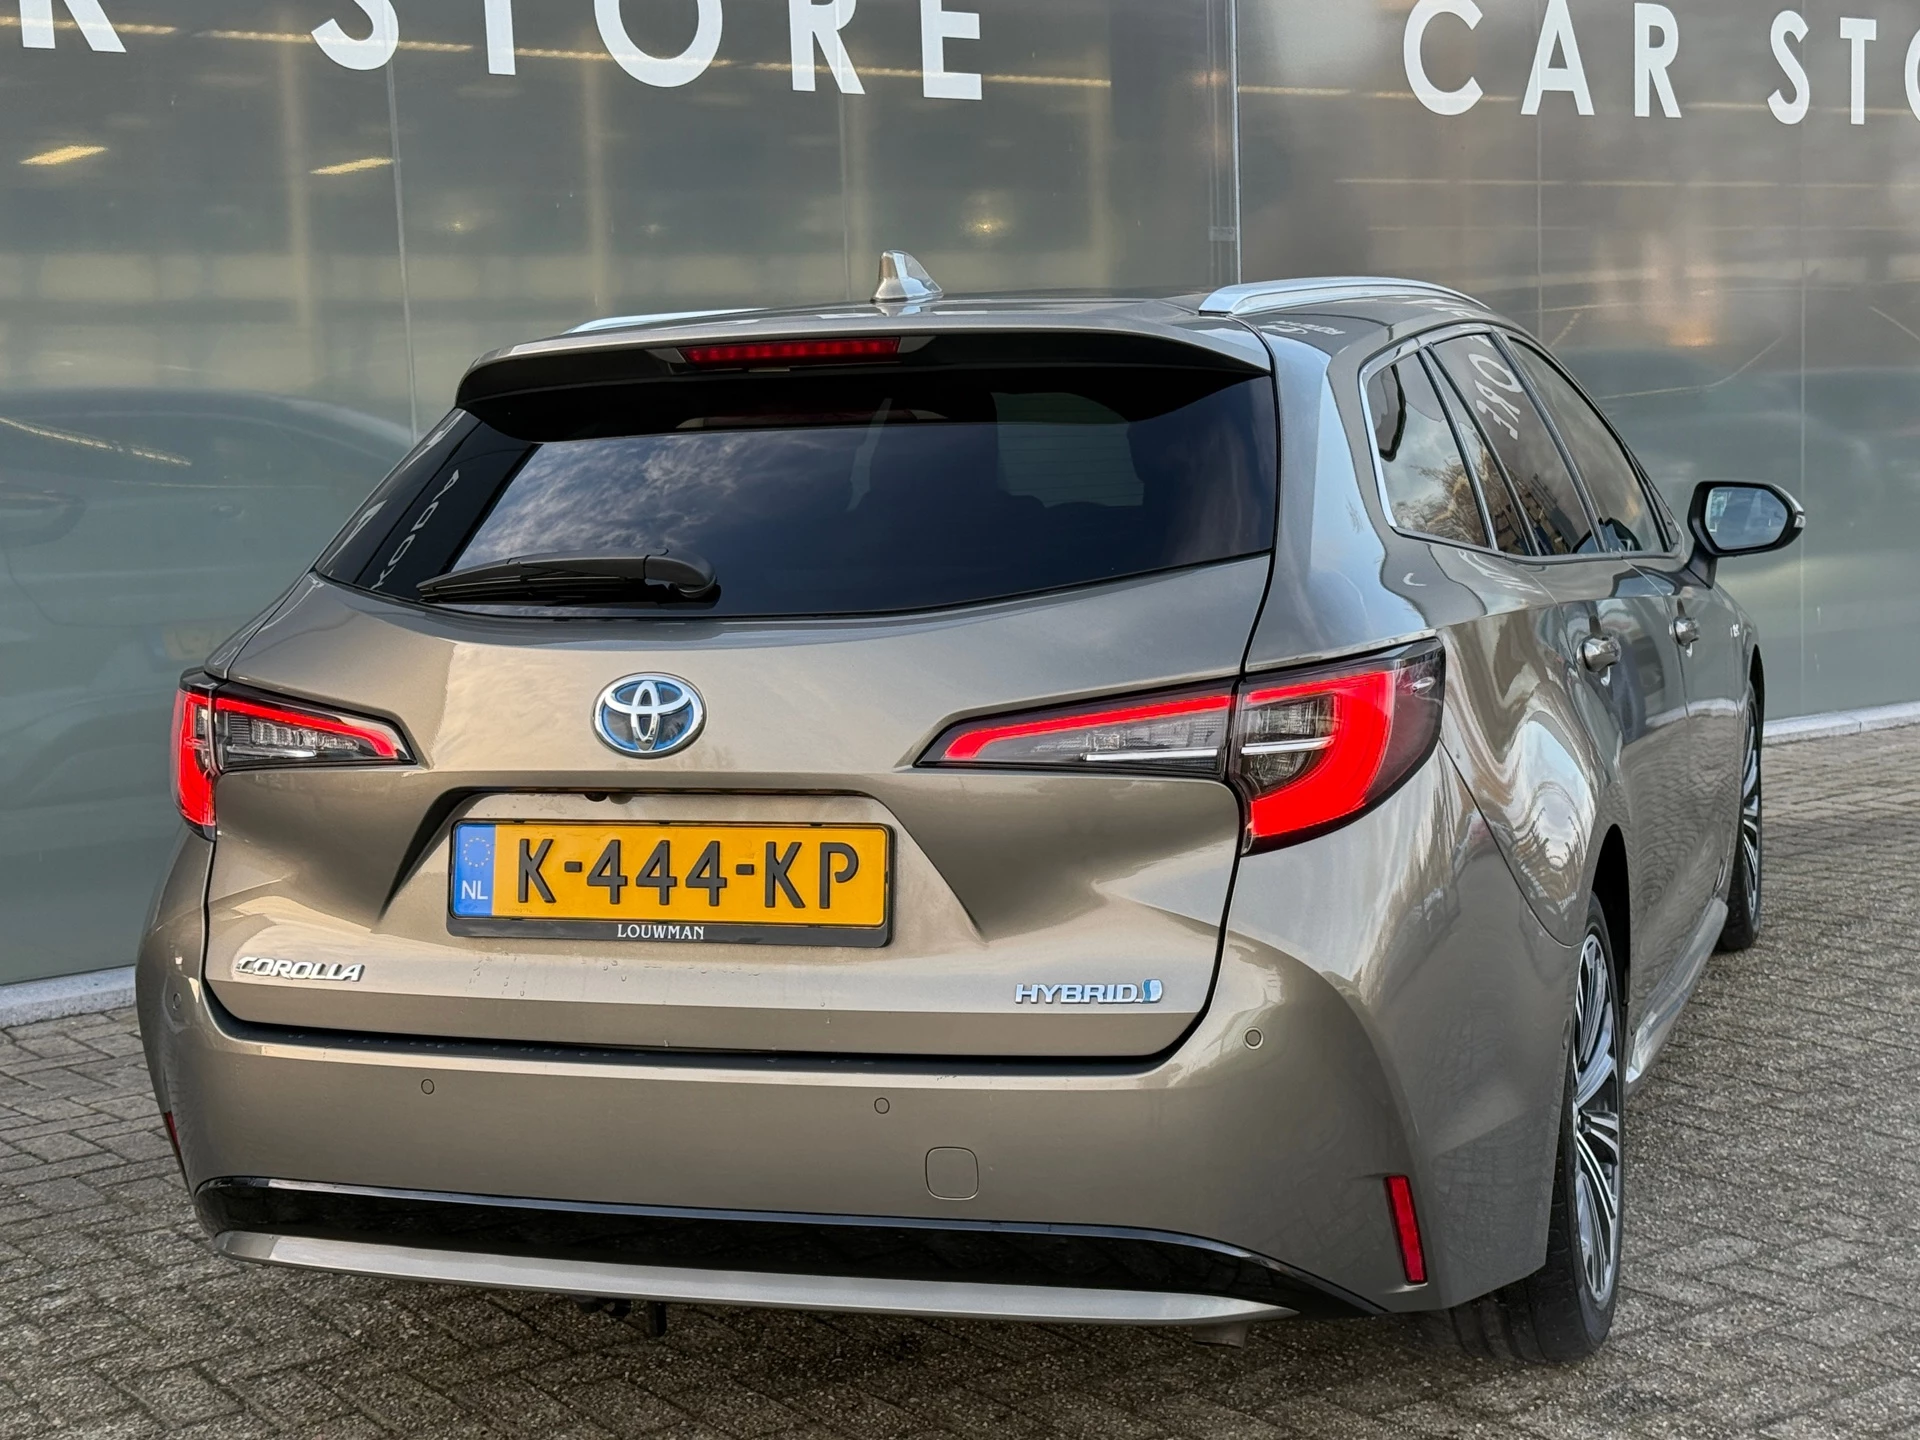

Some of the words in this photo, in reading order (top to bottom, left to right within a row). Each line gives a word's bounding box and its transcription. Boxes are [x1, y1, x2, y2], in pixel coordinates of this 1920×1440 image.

[1403, 0, 1682, 118] CAR
[1767, 10, 1920, 125] ST
[517, 838, 859, 909] K-444-KP
[461, 880, 488, 900] NL
[617, 924, 705, 940] LOUWMAN
[235, 956, 365, 982] COROLLA
[1015, 983, 1139, 1004] HYBRID
